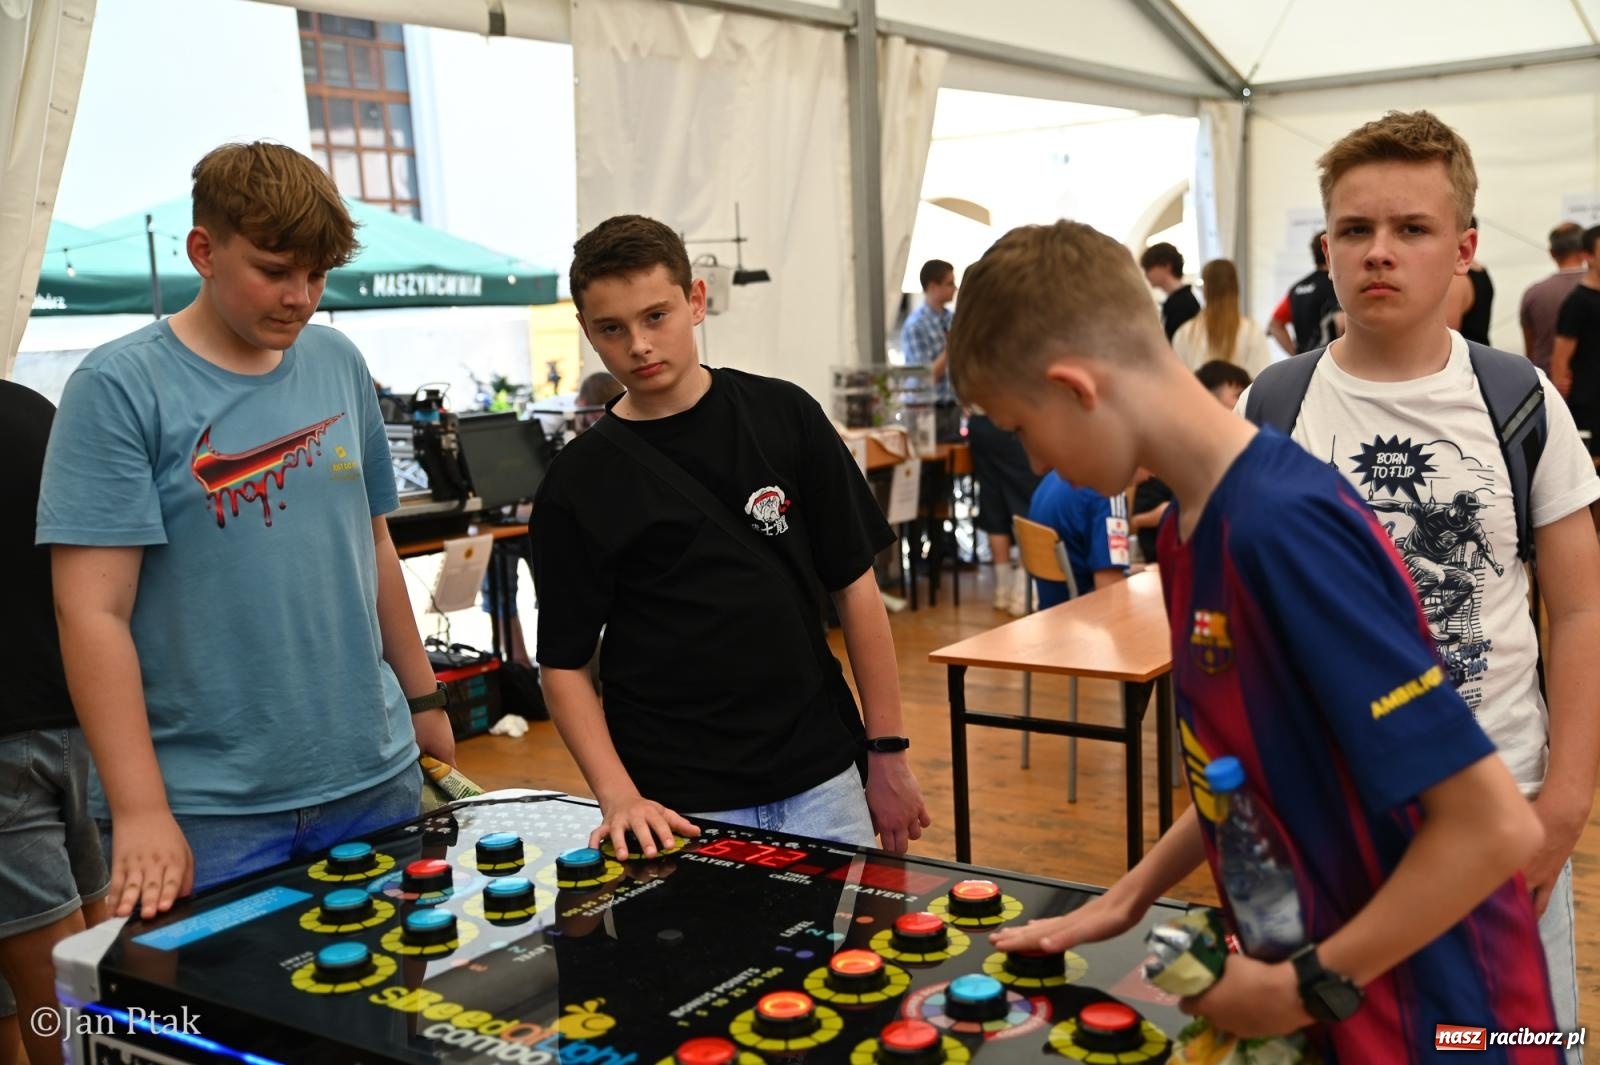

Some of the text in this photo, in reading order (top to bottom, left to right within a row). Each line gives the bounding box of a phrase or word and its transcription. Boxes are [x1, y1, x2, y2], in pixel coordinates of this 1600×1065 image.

[1376, 452, 1408, 465] BORN
[1371, 465, 1416, 479] TO FLIP
[680, 853, 736, 869] PLAYER
[699, 839, 807, 867] 672
[844, 884, 905, 900] PLAYER
[779, 920, 815, 938] LEVEL
